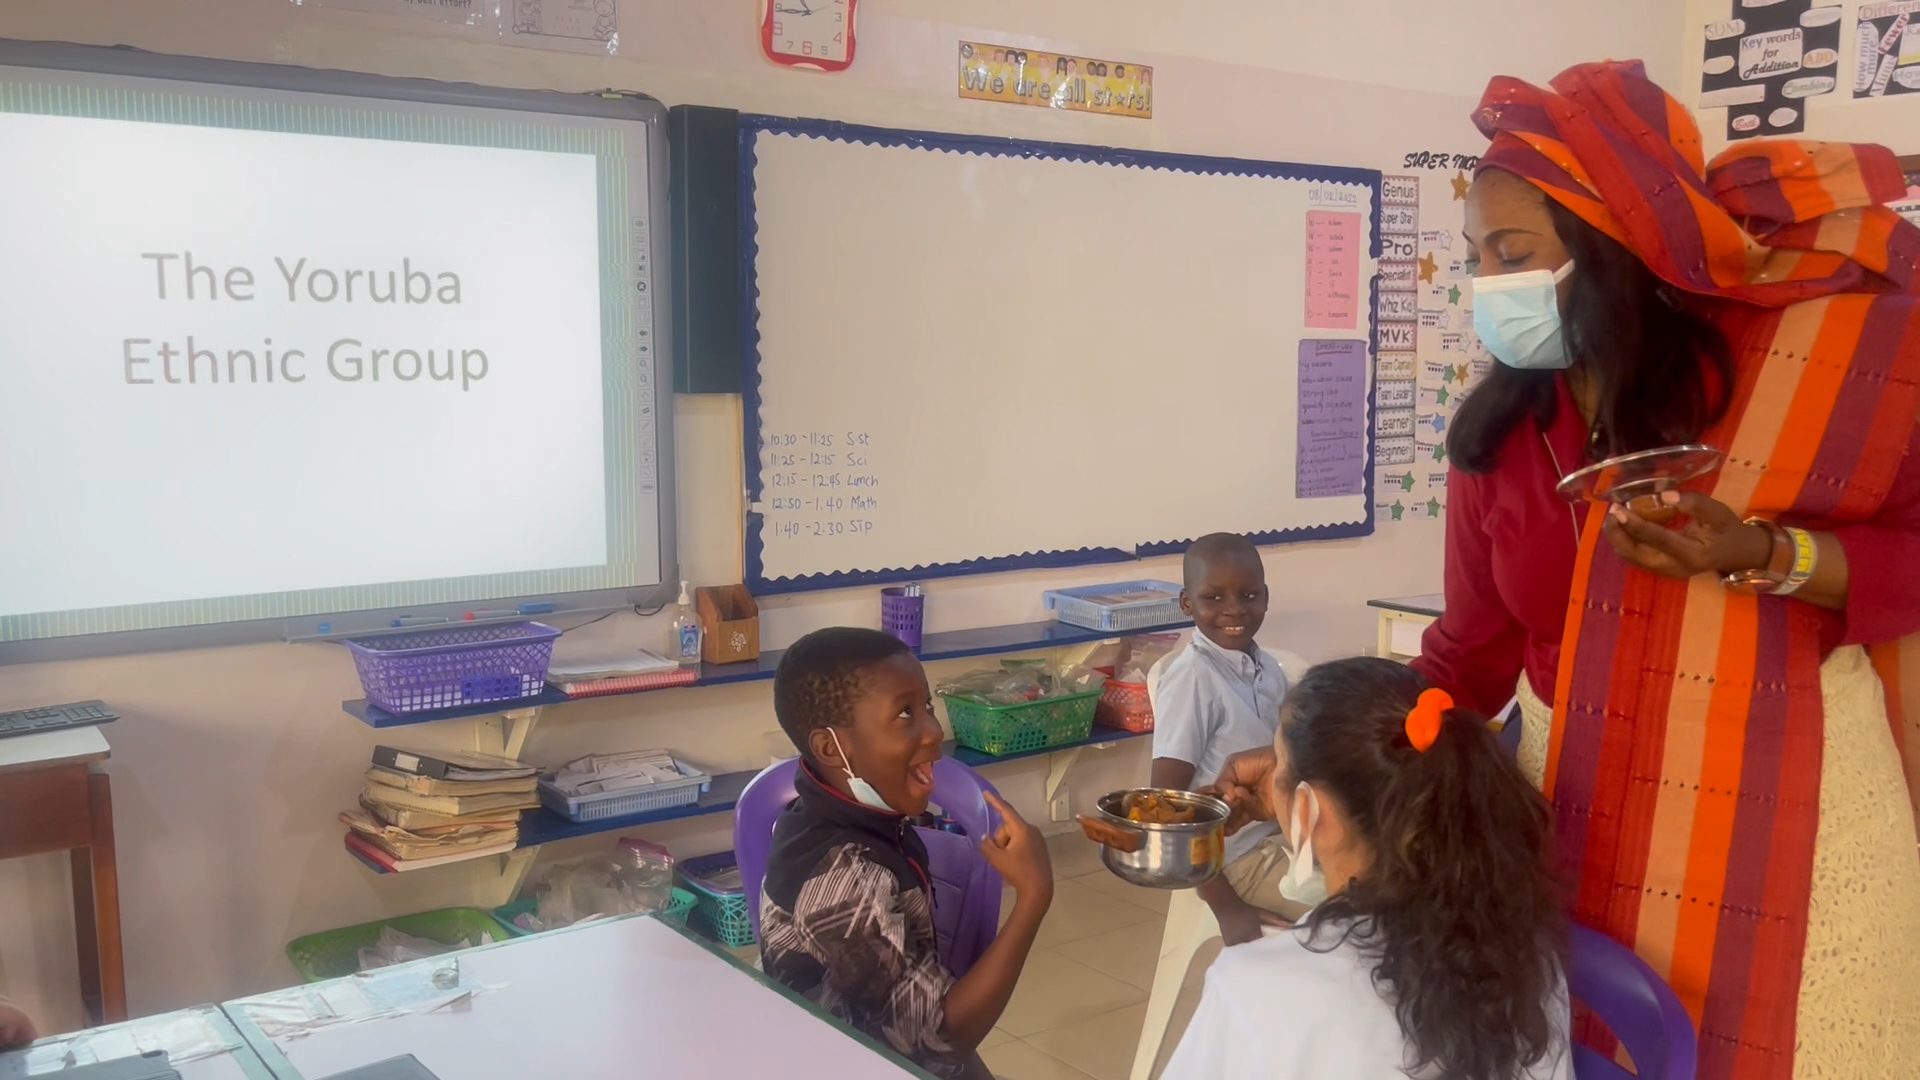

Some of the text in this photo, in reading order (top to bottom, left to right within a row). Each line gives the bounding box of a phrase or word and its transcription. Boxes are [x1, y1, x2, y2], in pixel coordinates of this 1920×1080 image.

[835, 12, 842, 22] 3
[1863, 2, 1920, 19] Differen
[773, 21, 783, 36] 8
[1878, 13, 1909, 53] Fewer
[786, 40, 794, 49] 7
[833, 31, 842, 44] 4
[1741, 29, 1802, 50] Key words
[1860, 22, 1871, 58] much
[802, 41, 812, 55] 6
[821, 45, 828, 55] 5
[1762, 48, 1779, 61] for
[1743, 60, 1799, 79] Addition
[963, 66, 1004, 94] We
[1013, 78, 1051, 101] are
[1403, 151, 1477, 171] SUPER IMP
[1382, 181, 1414, 198] Genius
[1380, 239, 1413, 256] Pro
[141, 251, 462, 305] The Yoruba
[1379, 328, 1410, 344] MVK
[123, 336, 489, 391] Ethnic Group
[1378, 358, 1393, 371] Team
[1378, 387, 1392, 400] Team
[1377, 415, 1410, 431] Learner
[770, 434, 797, 446] 10:30
[810, 432, 833, 446] 11:25
[770, 453, 795, 466] 11:25
[810, 452, 836, 466] 12:15
[846, 452, 867, 467] Sci
[772, 473, 797, 488] 12:15
[847, 475, 879, 487] Lunch
[772, 497, 801, 509] 12:50
[851, 495, 877, 510] Math
[775, 521, 799, 539] 1:40
[813, 521, 844, 536] 2:30
